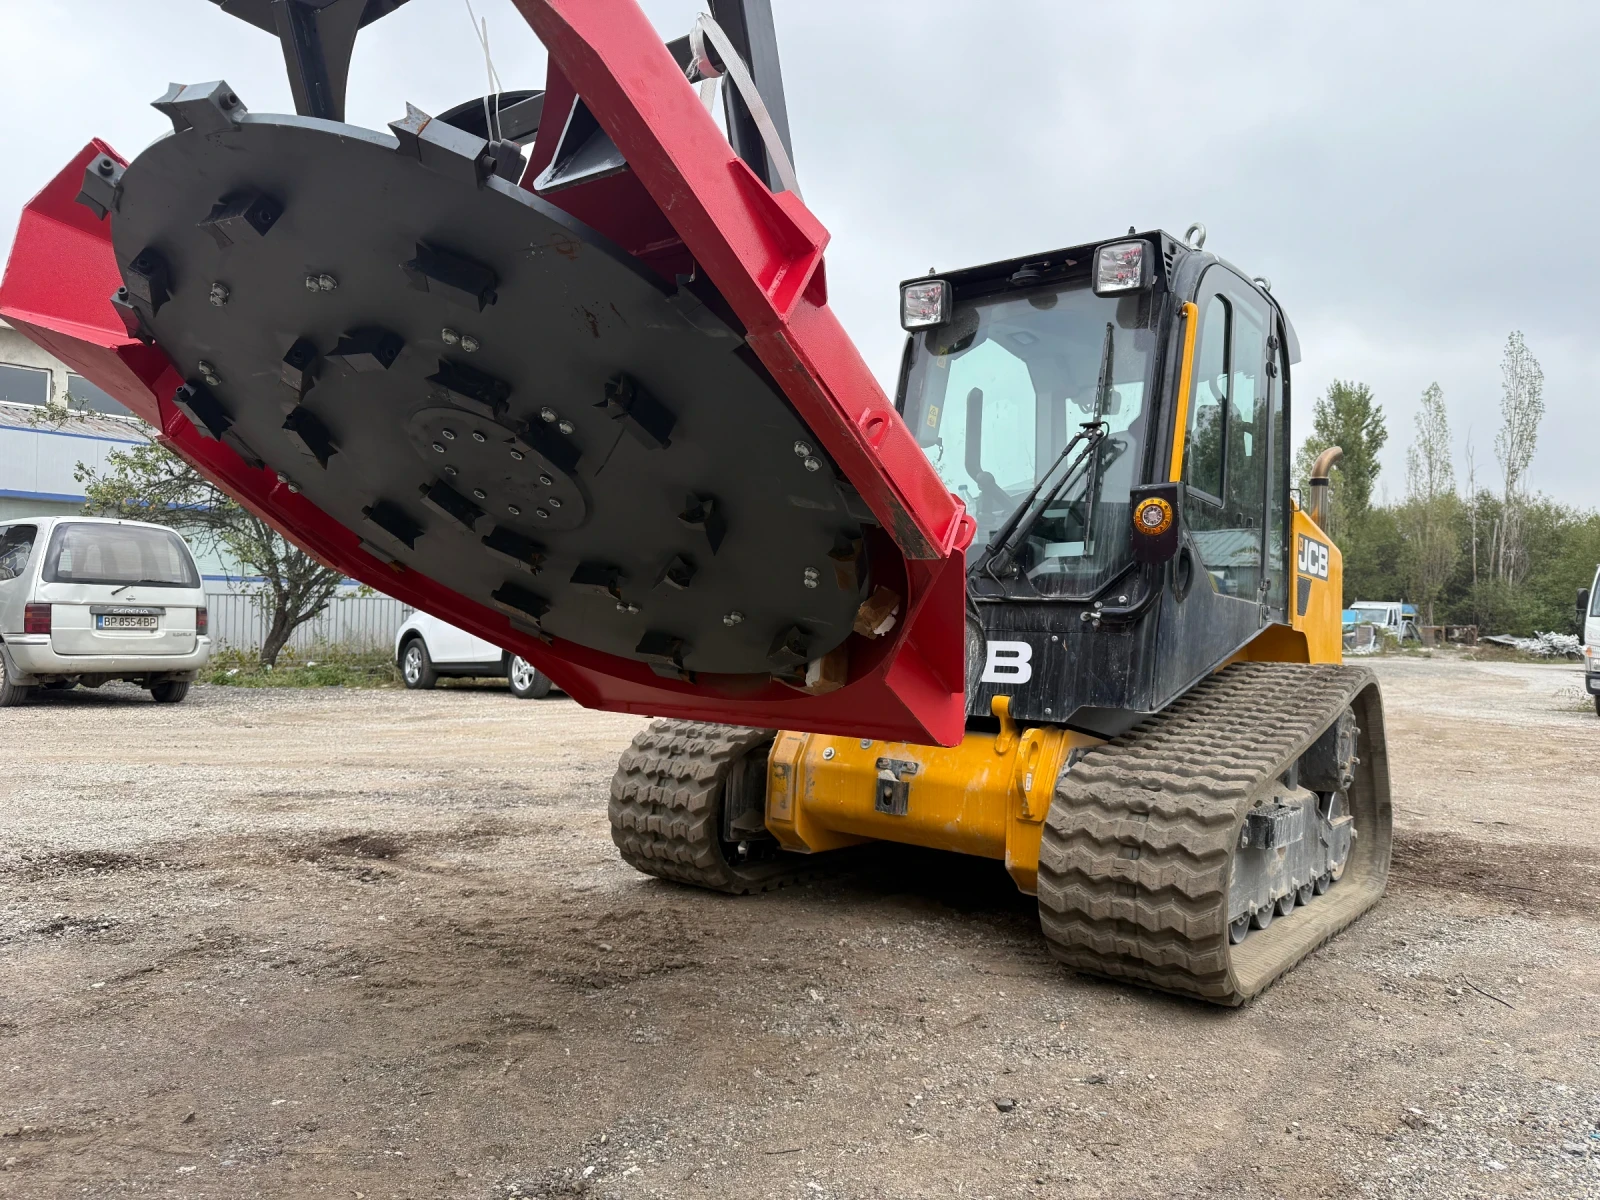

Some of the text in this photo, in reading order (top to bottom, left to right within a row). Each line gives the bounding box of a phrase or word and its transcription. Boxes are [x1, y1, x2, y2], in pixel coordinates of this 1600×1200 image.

[1298, 539, 1328, 578] JCB
[104, 617, 156, 627] BP 8554 BP
